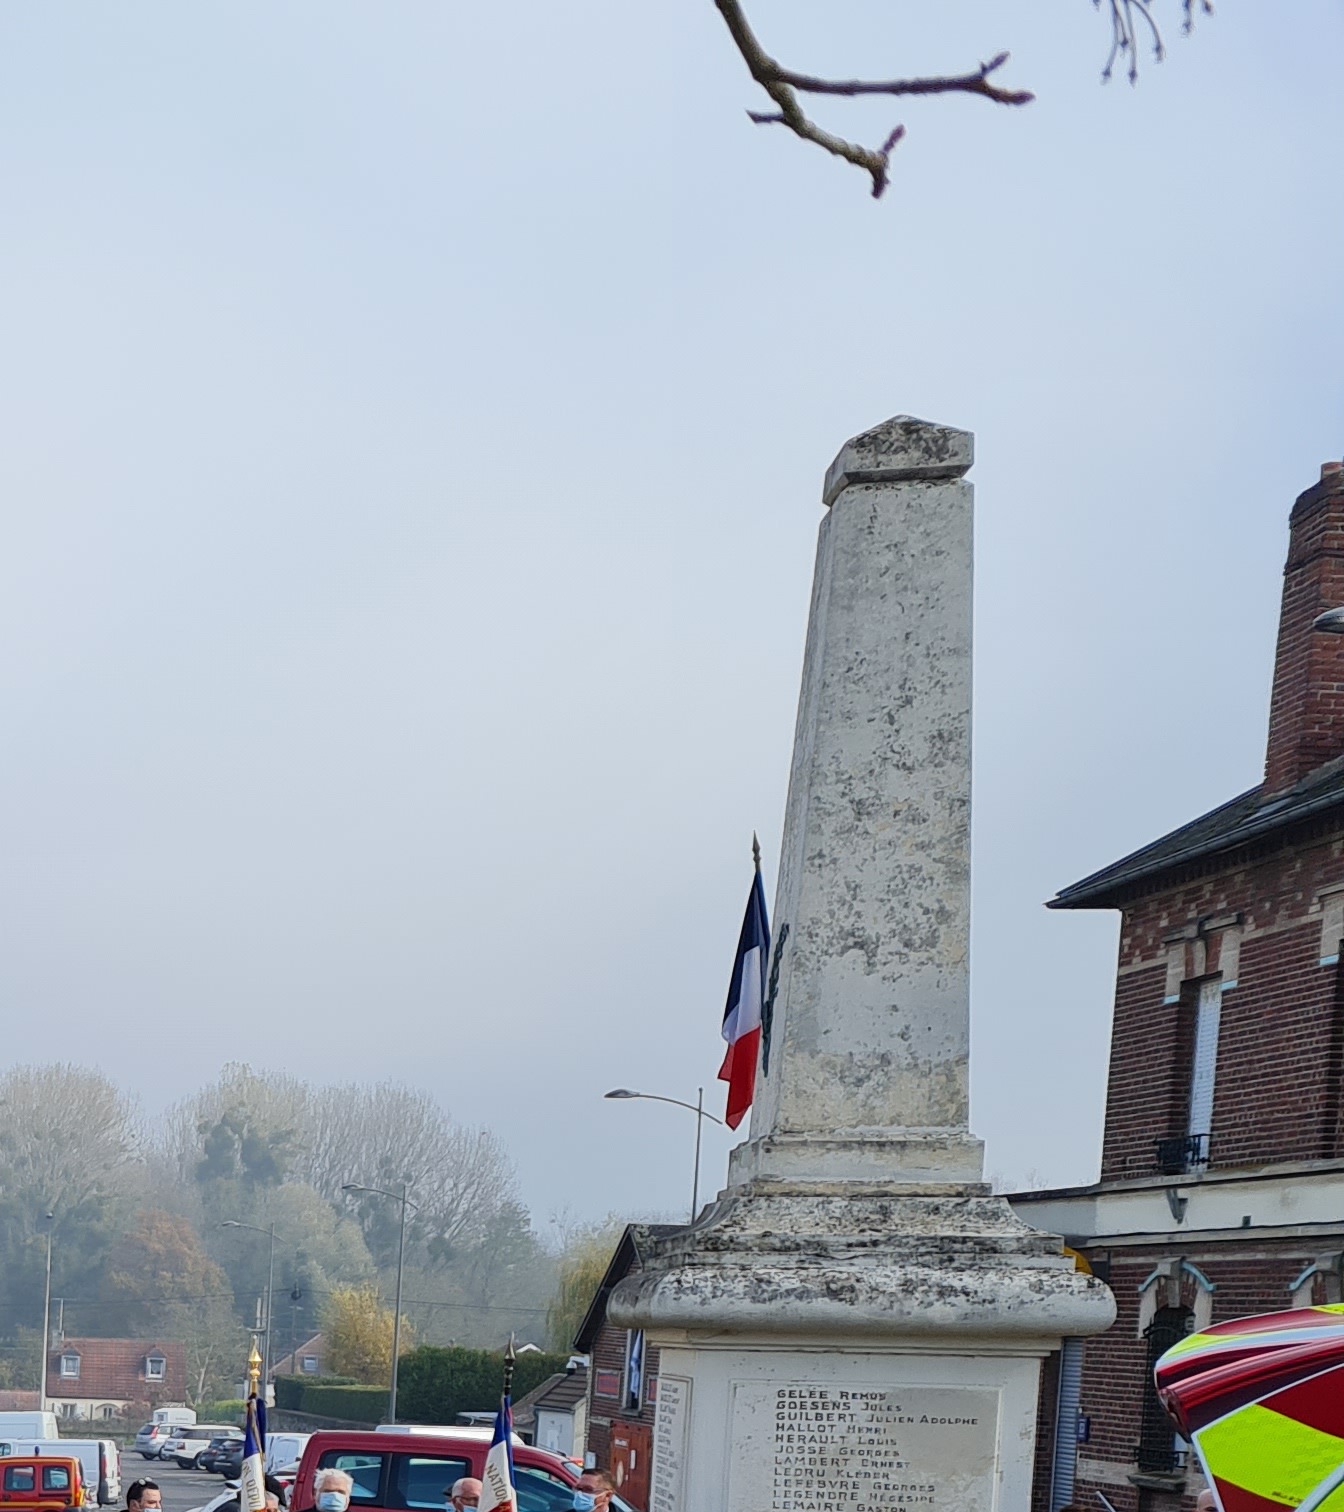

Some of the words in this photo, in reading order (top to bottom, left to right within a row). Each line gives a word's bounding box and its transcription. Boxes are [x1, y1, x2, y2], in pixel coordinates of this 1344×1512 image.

[776, 1401, 851, 1411] GOESENS
[861, 1402, 902, 1412] JULES
[776, 1412, 856, 1422] GUILBERT
[865, 1414, 914, 1424] JULIEN
[919, 1415, 979, 1425] ADOLPHE
[776, 1423, 836, 1433] HALLOT
[776, 1445, 827, 1455] JOSSE
[839, 1447, 900, 1457] GEORGES
[775, 1456, 850, 1466] LAMBERT
[774, 1467, 826, 1477] LEDRU
[773, 1490, 859, 1501] LEGENDRE
[772, 1501, 844, 1512] LEMAIRE
